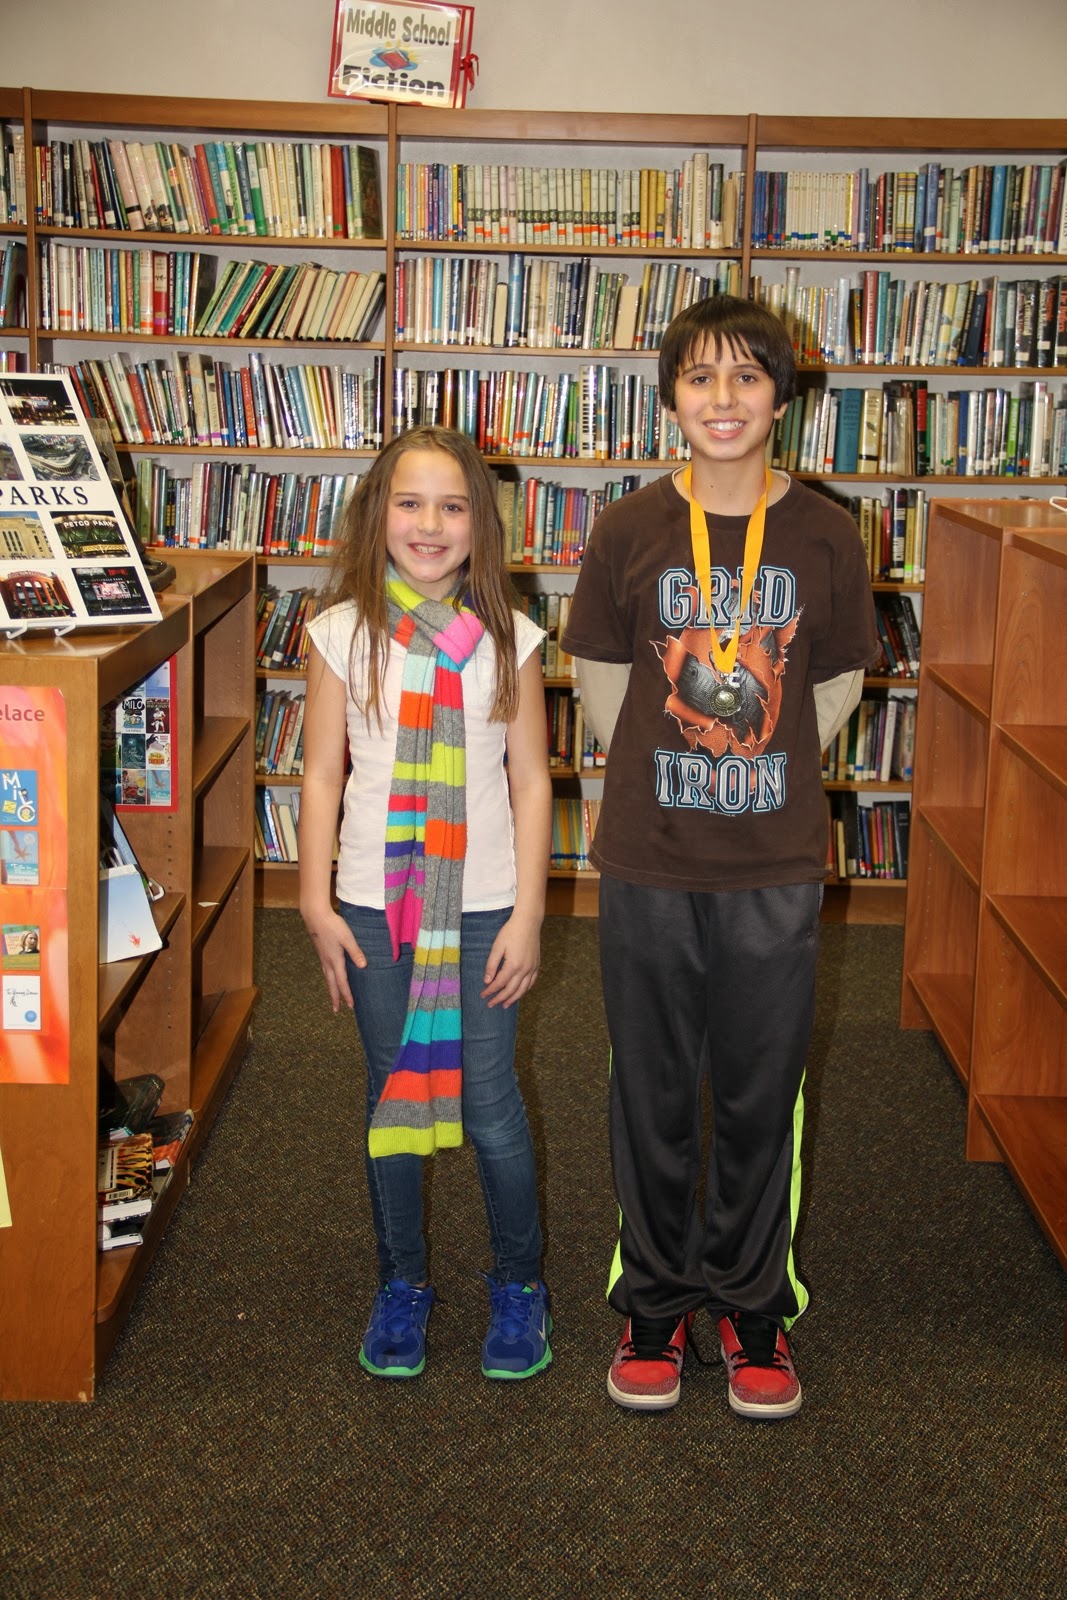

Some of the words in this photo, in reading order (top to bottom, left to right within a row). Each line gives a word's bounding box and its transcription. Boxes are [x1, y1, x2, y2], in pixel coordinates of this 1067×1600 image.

[346, 8, 397, 39] Middle
[402, 14, 451, 45] School
[342, 64, 445, 97] Fiction
[64, 520, 90, 528] PETCO
[93, 519, 115, 528] PARK
[658, 565, 796, 629] GRID
[123, 699, 143, 711] MILO
[654, 749, 786, 814] IRON
